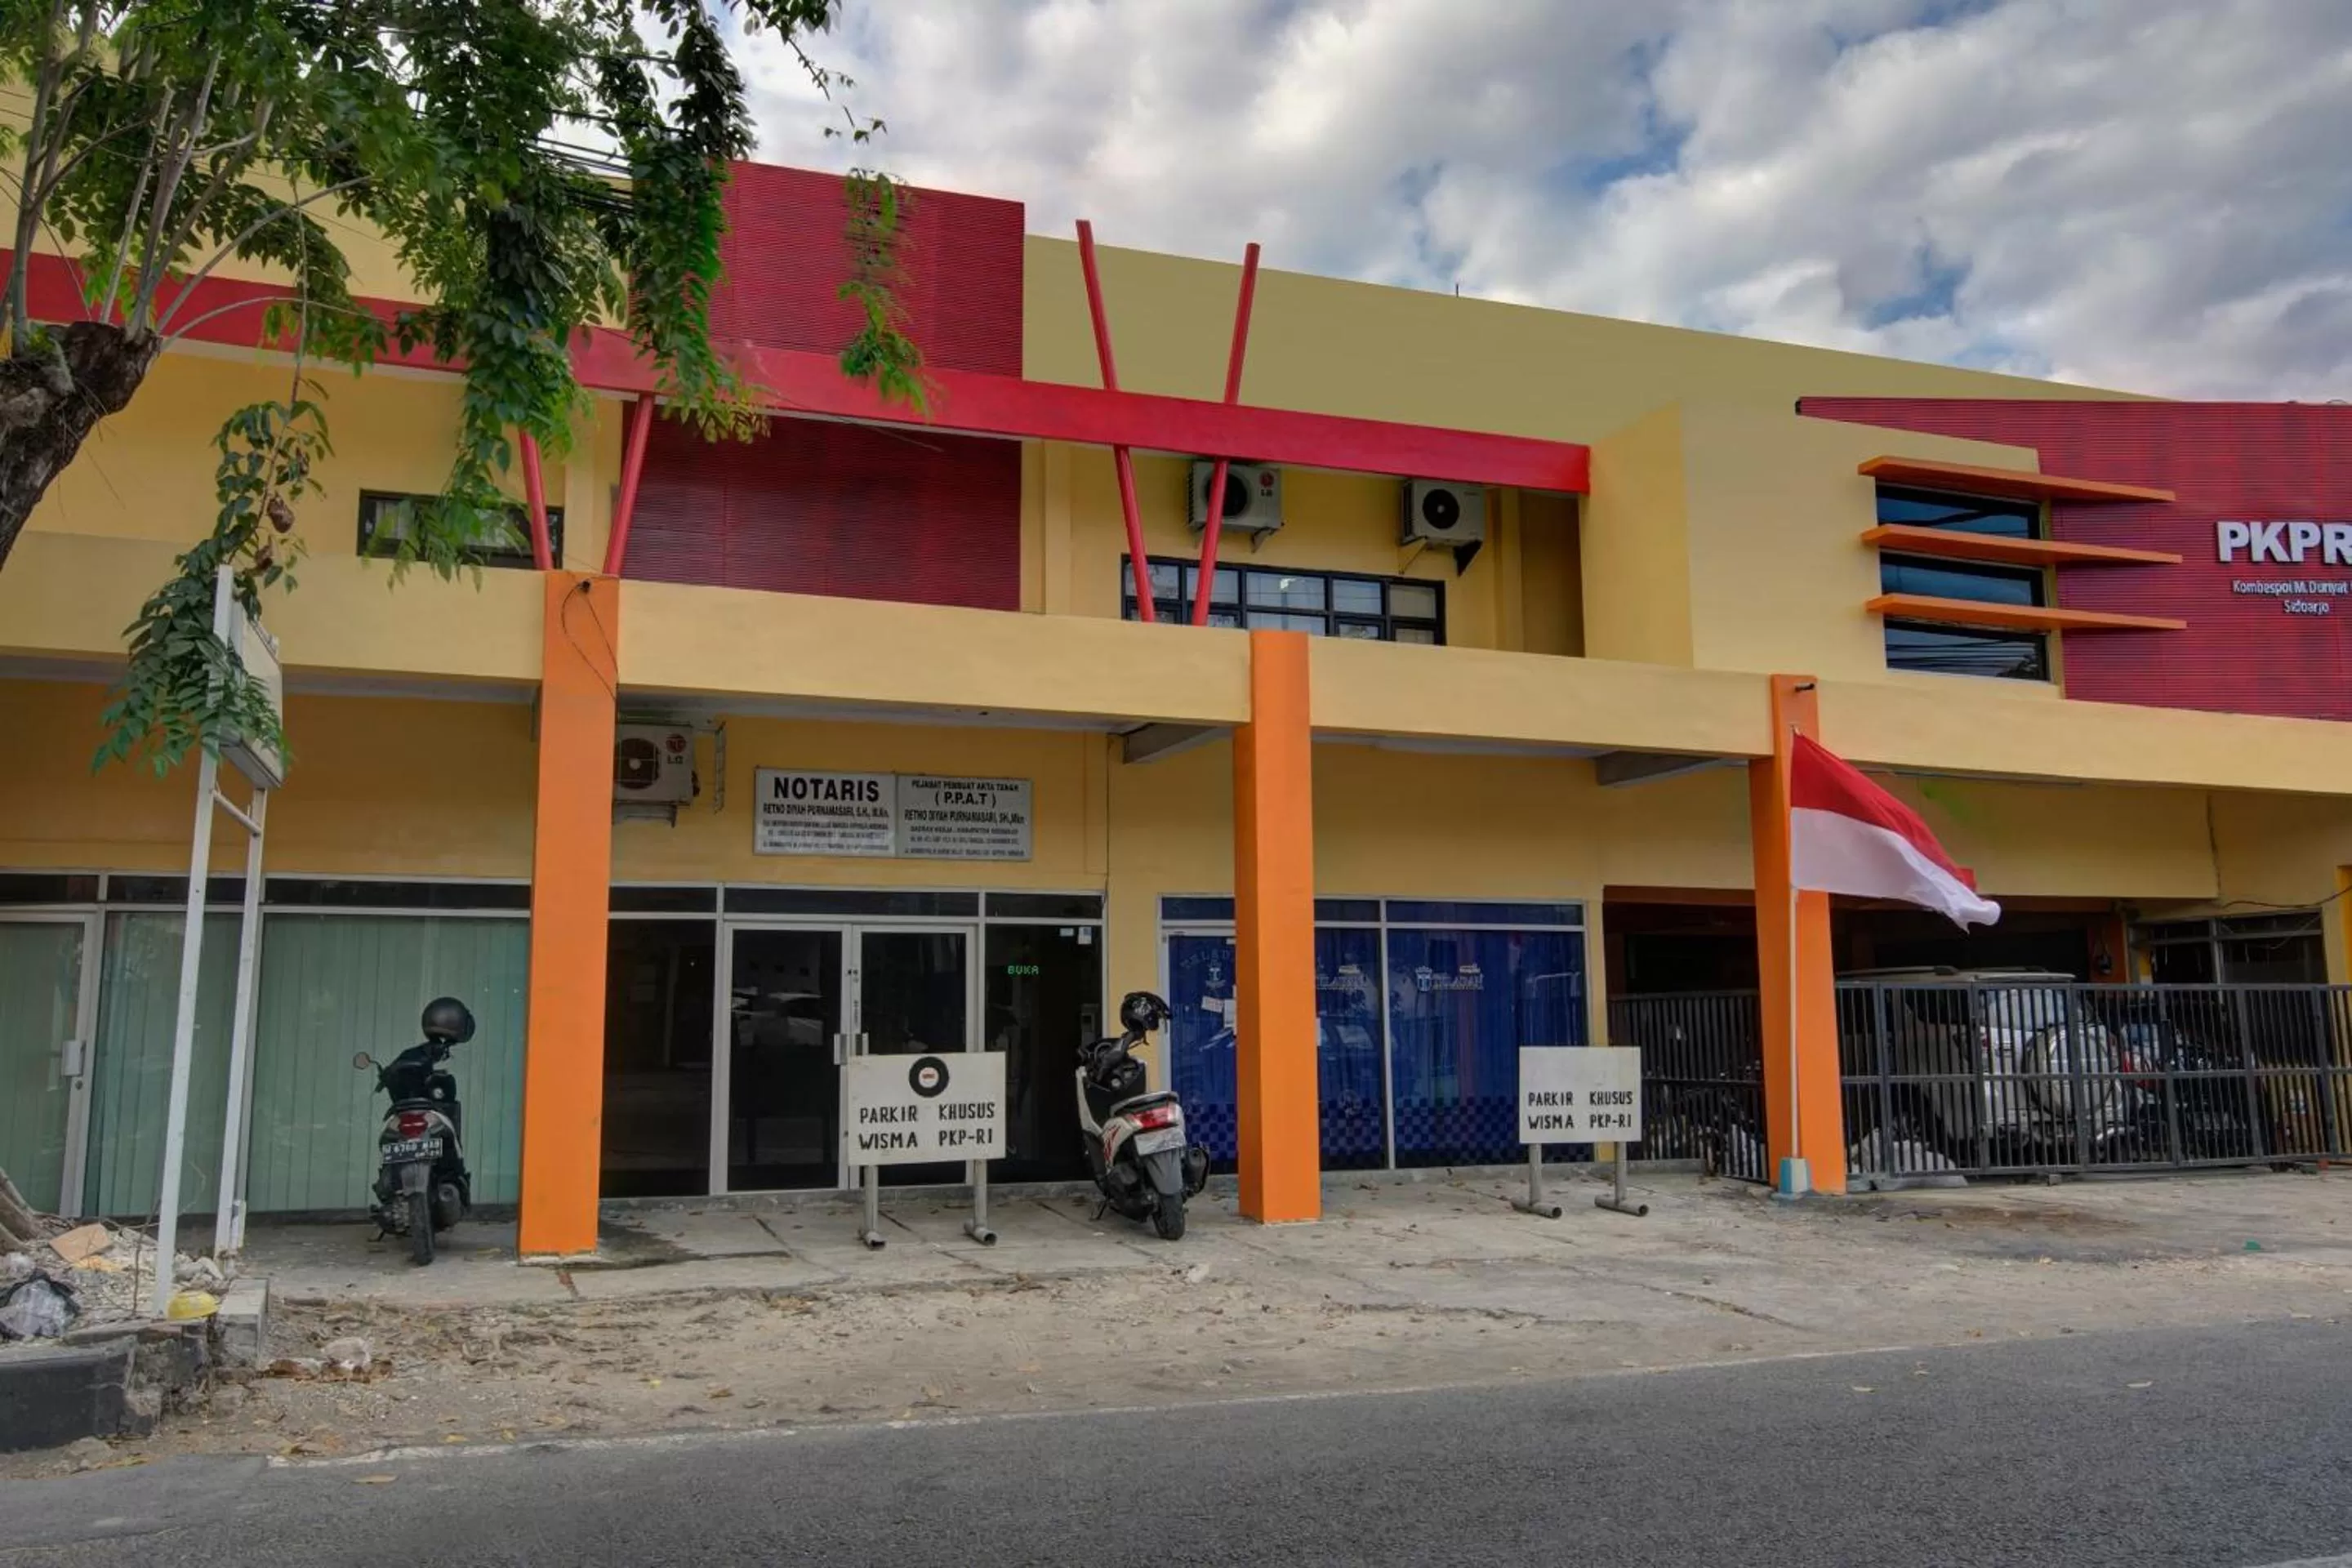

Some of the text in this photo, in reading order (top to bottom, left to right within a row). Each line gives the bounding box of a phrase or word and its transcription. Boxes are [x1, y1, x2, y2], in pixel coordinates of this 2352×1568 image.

[2216, 520, 2352, 565] PKPR
[773, 776, 880, 803] NOTARIS
[1007, 965, 1040, 975] BUKA
[1528, 1090, 1633, 1107] PARKIR KHUSUS
[859, 1102, 996, 1125] PARKIR KHUSUS
[1528, 1113, 1632, 1130] WISMA PKP-RI
[859, 1128, 993, 1151] WISMA PKP-RI
